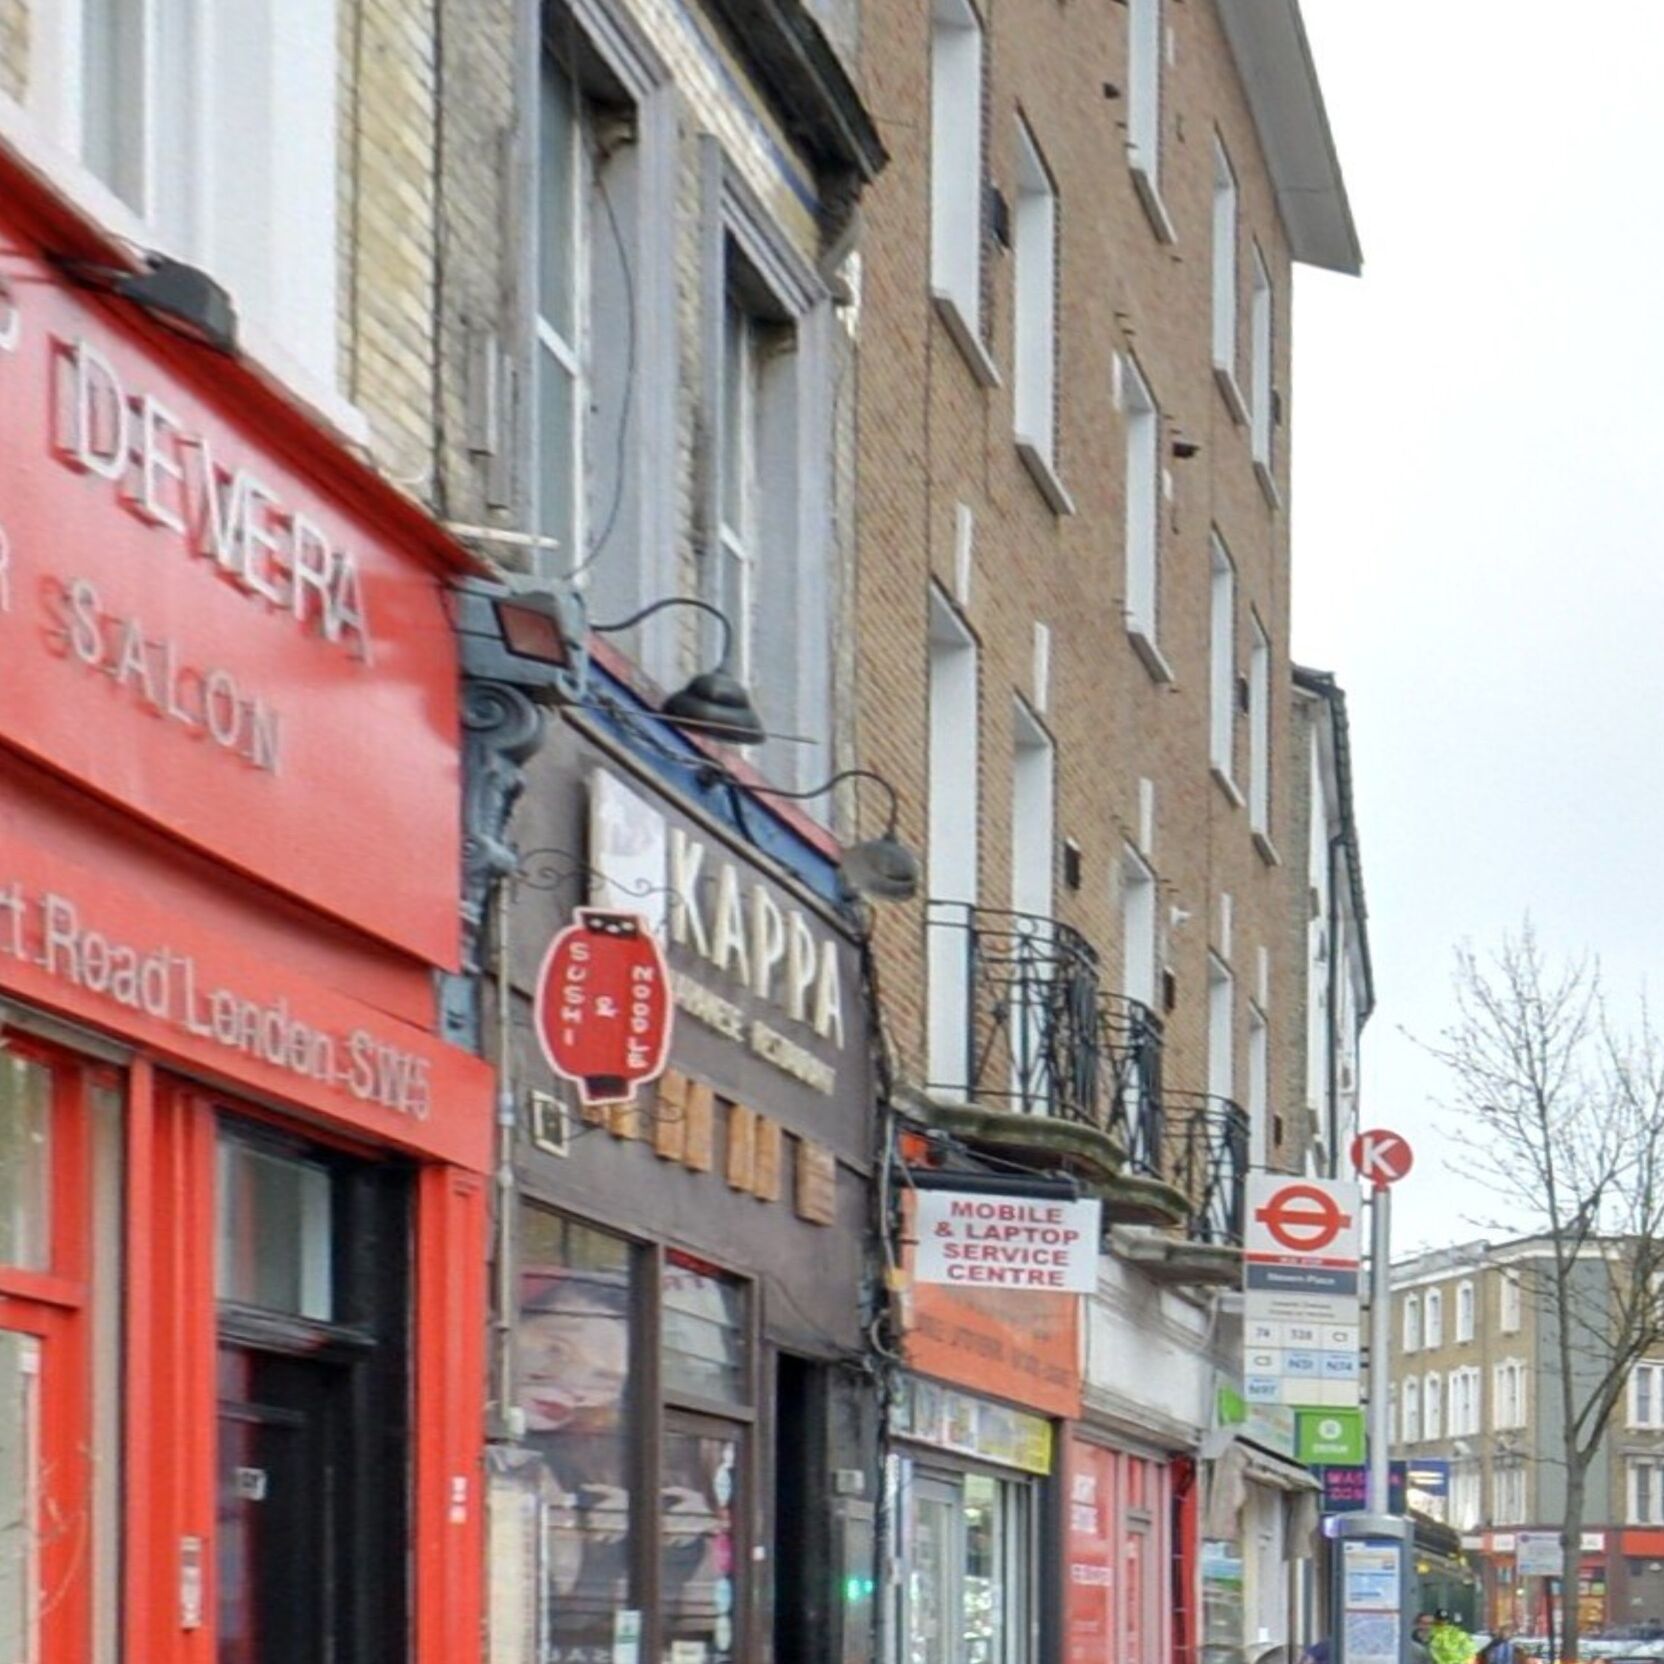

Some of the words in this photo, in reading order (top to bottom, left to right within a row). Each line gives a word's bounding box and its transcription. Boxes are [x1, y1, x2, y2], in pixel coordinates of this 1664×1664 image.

[68, 576, 281, 776] SALON
[669, 827, 845, 1051] KAPPA
[41, 892, 172, 1018] Road
[181, 954, 336, 1084] London
[559, 941, 592, 1047] SUSHI
[626, 965, 654, 1069] NOODLE
[1361, 1137, 1398, 1177] K
[933, 1221, 954, 1238] &
[965, 1223, 1080, 1246] LAPTOP
[951, 1200, 1063, 1225] MOBILE
[942, 1243, 1070, 1267] SERVICE
[946, 1264, 1065, 1287] CENTRE
